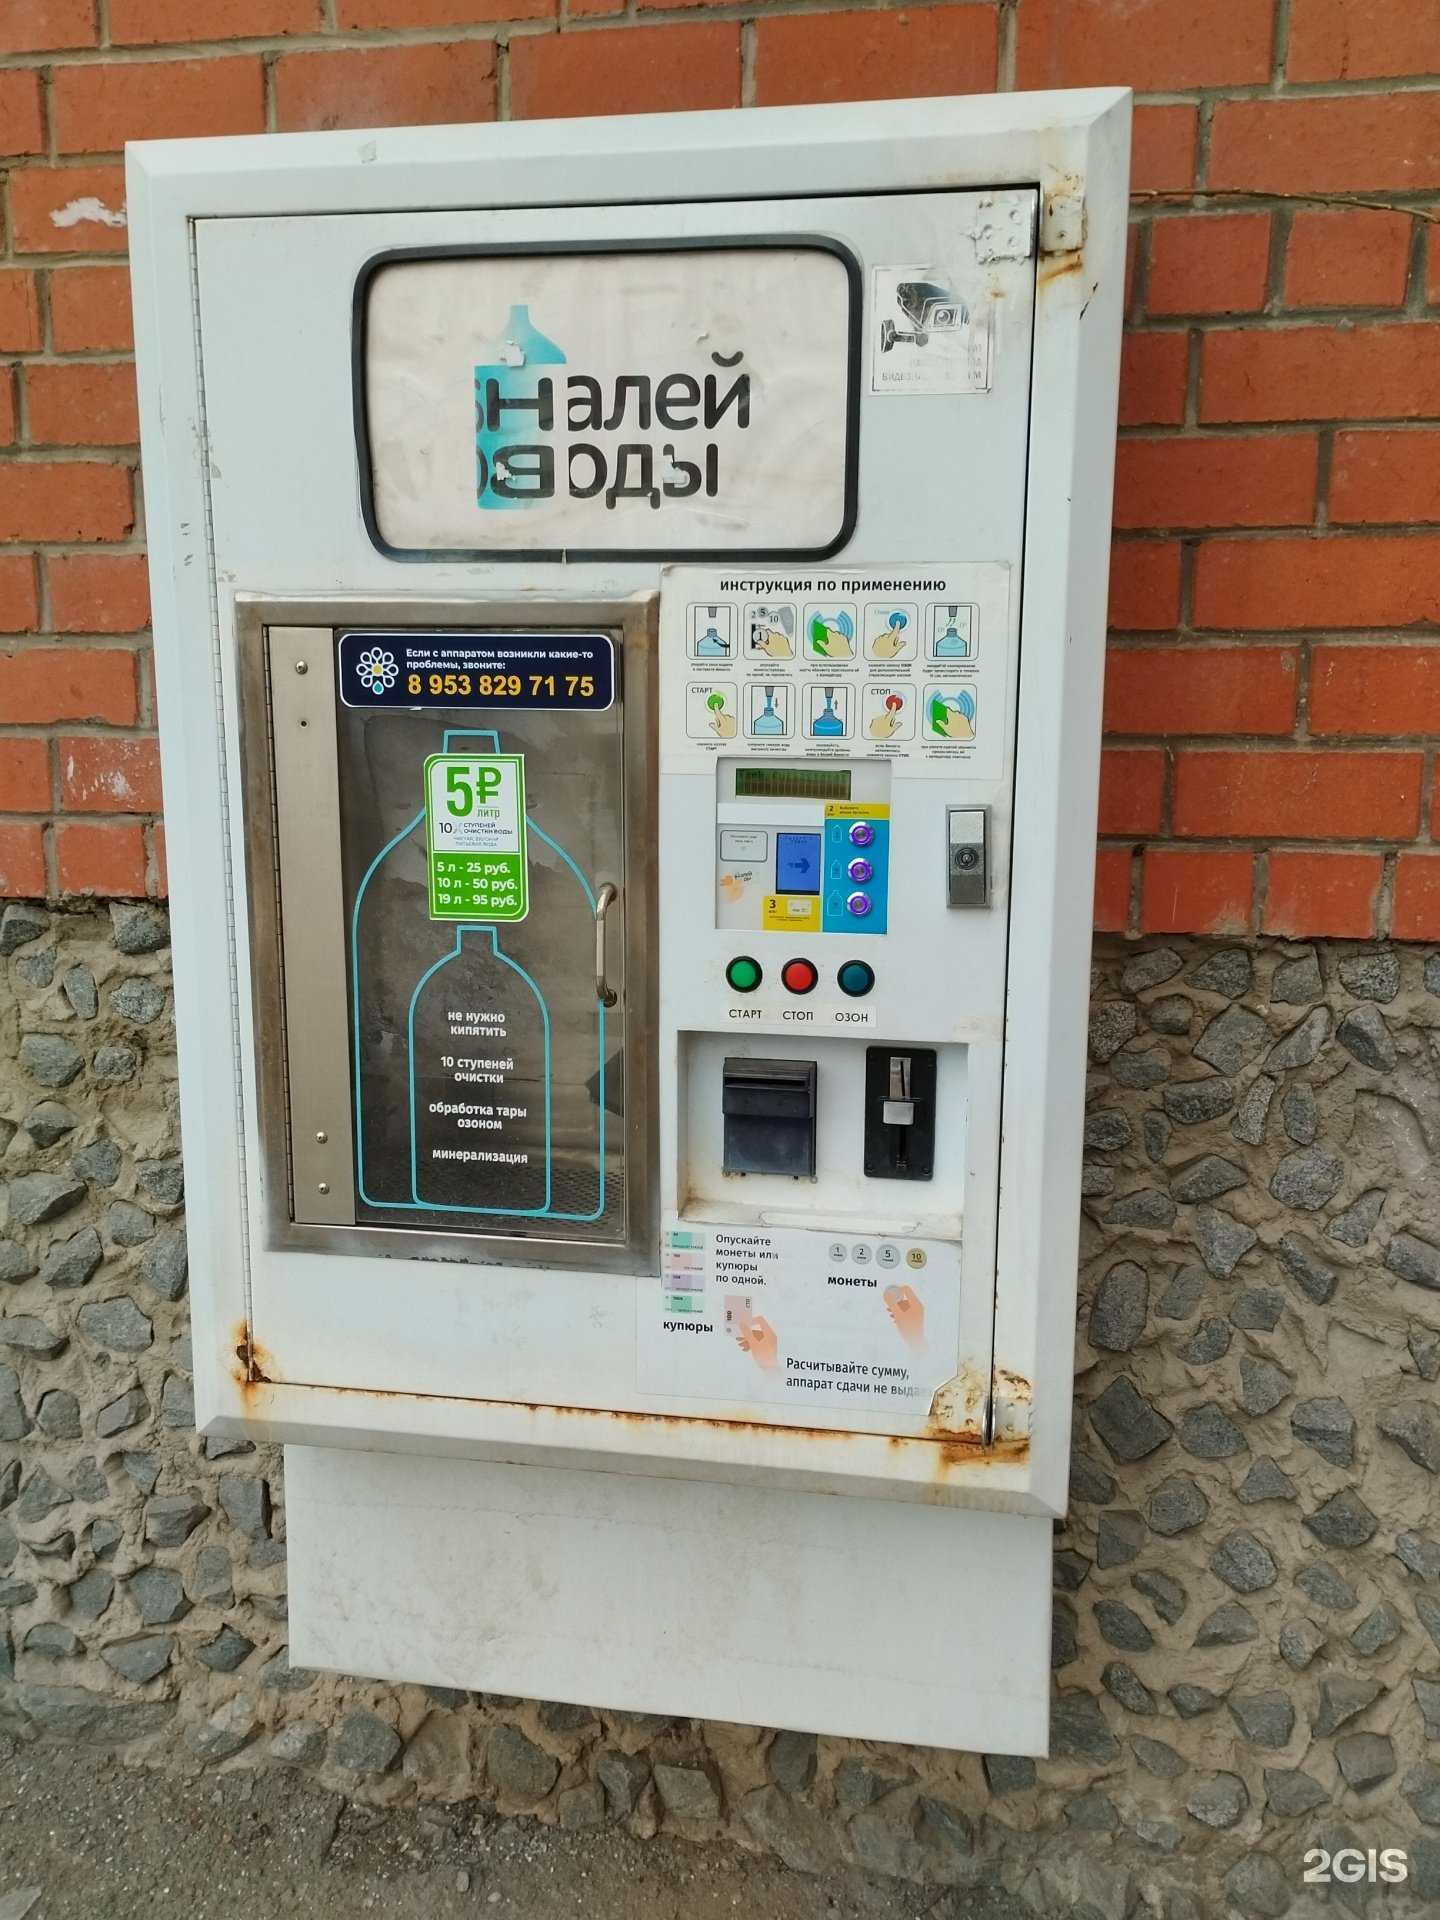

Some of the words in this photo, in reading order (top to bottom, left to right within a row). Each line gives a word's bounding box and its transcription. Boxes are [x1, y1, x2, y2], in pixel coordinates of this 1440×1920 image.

[720, 579, 812, 594] инструкция
[817, 581, 836, 592] по
[841, 580, 947, 594] применению
[406, 649, 431, 658] Если
[440, 650, 495, 660] аппаратом
[497, 651, 546, 659] возникли
[548, 651, 594, 659] какие-то
[406, 660, 461, 671] проблемы,
[463, 661, 506, 670] звоните:
[408, 674, 422, 695] 8
[429, 674, 472, 696] 953
[479, 675, 522, 696] 829
[529, 675, 556, 696] 71
[565, 676, 595, 697] 75
[477, 808, 500, 819] литр
[437, 862, 445, 872] 5
[447, 864, 456, 872] л
[466, 862, 481, 873] 25
[484, 862, 511, 876] руб.
[437, 877, 451, 888] 10
[454, 880, 462, 888] л
[473, 879, 488, 889] 50
[491, 878, 518, 892] руб.
[438, 893, 451, 904] 19
[454, 896, 462, 904] л
[473, 895, 488, 905] 95
[491, 894, 517, 908] руб.
[769, 899, 776, 909] 3
[448, 1011, 462, 1021] не
[466, 1012, 506, 1024] нужно
[728, 1009, 762, 1020] СТАРТ
[782, 1011, 814, 1021] СТОП
[835, 1013, 868, 1023] ОЗОН
[450, 1025, 507, 1037] кипятить
[440, 1056, 454, 1067] 10
[457, 1057, 514, 1071] ступеней
[454, 1072, 504, 1083] очистки
[429, 1101, 493, 1116] обработка
[496, 1107, 527, 1119] тары
[457, 1118, 502, 1129] озоном
[432, 1149, 528, 1165] минерализация
[715, 1234, 771, 1248] Опускайте
[715, 1249, 756, 1259] монеты
[885, 1249, 890, 1258] 5
[715, 1261, 758, 1273] купюры
[715, 1274, 729, 1283] по
[731, 1275, 767, 1287] одной.
[828, 1276, 877, 1288] монеты
[663, 1320, 713, 1334] купюры
[786, 1357, 869, 1375] Расчитывайте
[871, 1365, 910, 1380] сумму,
[786, 1377, 833, 1391] аппарат
[836, 1381, 870, 1393] сдачи
[873, 1385, 887, 1394] не
